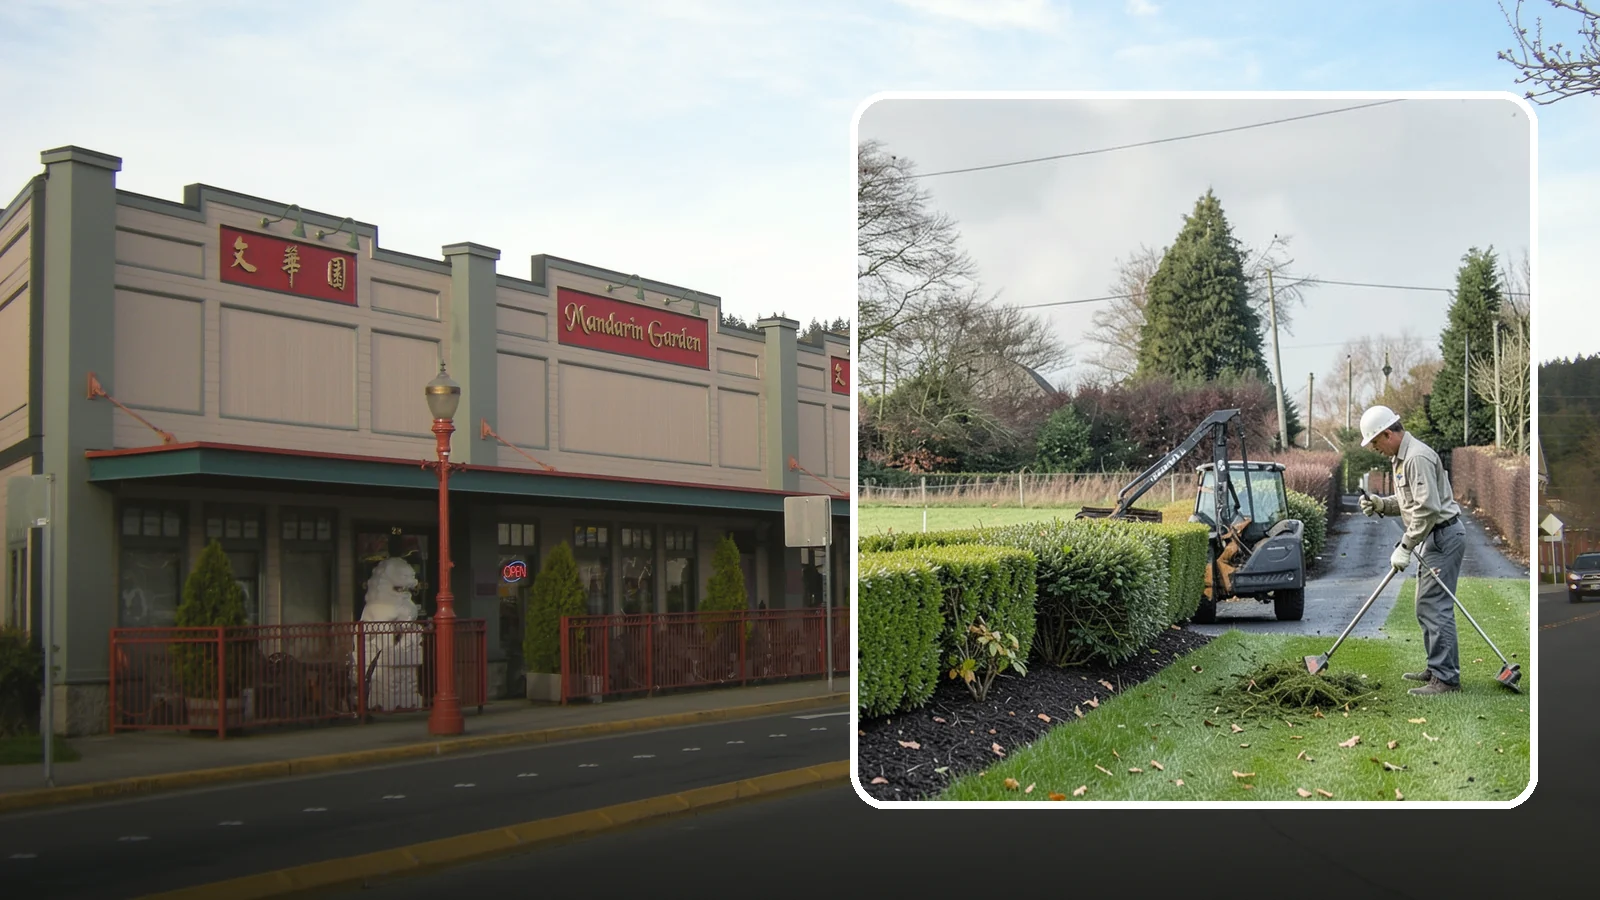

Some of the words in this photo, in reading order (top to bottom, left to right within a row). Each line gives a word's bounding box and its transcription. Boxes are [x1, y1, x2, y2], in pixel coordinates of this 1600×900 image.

[564, 302, 644, 341] Mandarin
[648, 320, 701, 352] Garden
[503, 565, 527, 578] OPEN
